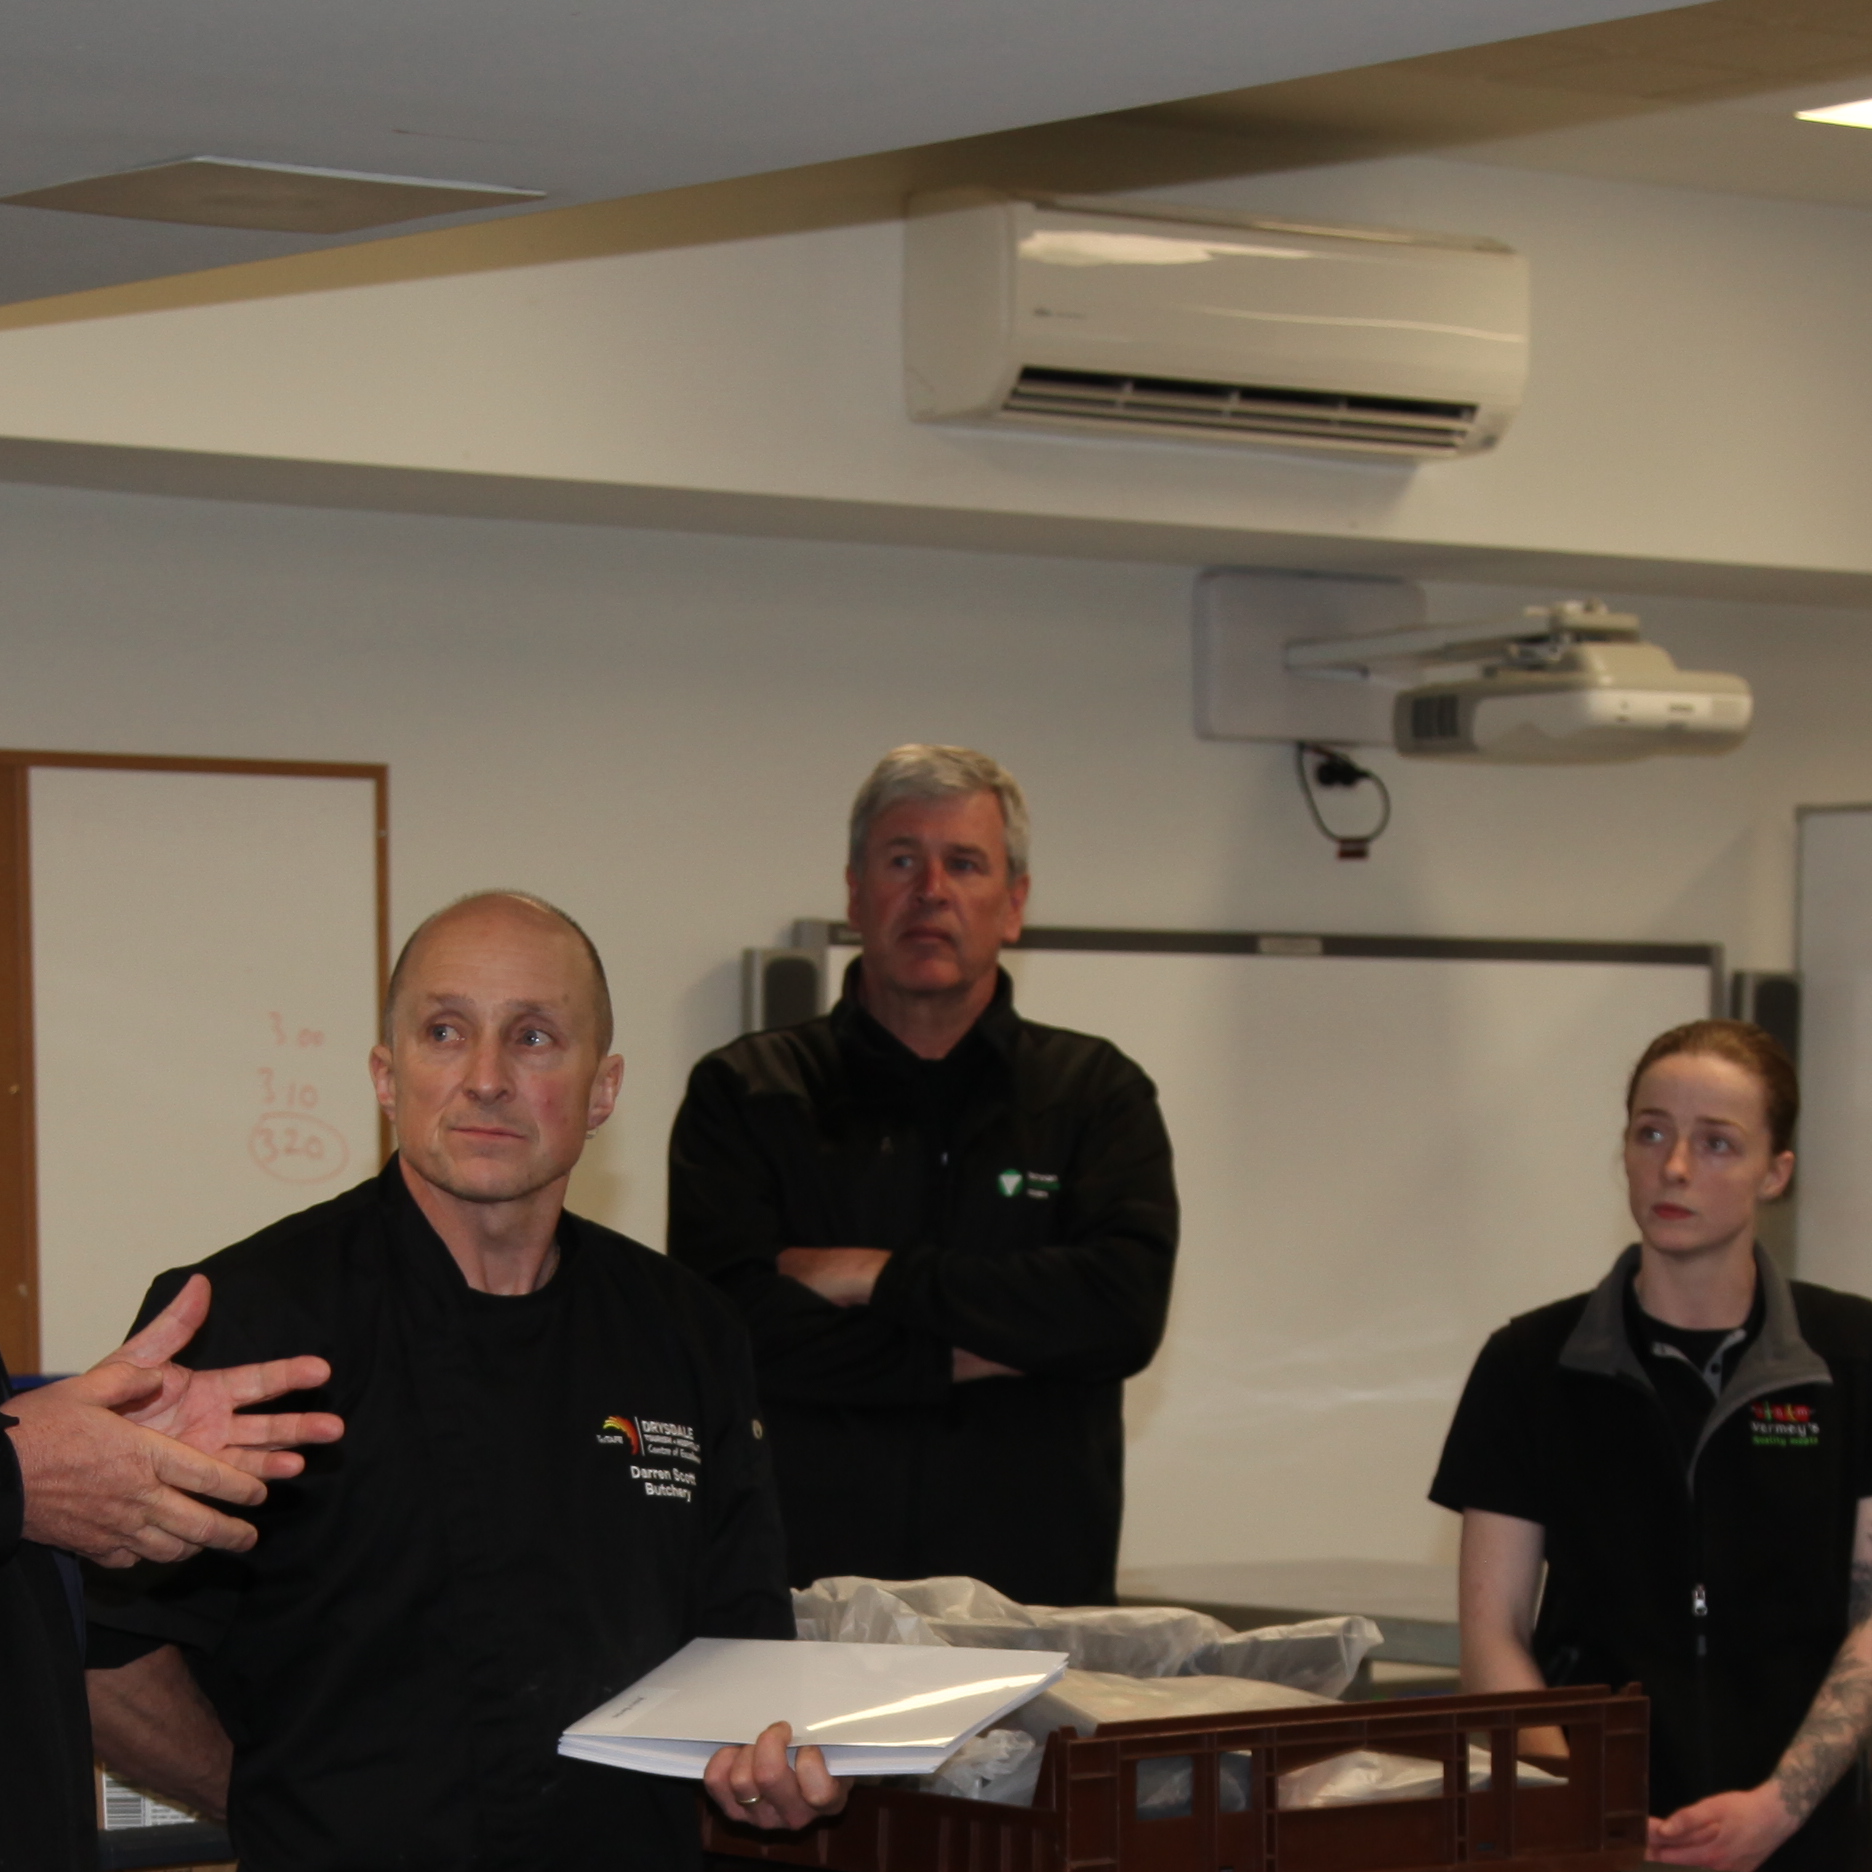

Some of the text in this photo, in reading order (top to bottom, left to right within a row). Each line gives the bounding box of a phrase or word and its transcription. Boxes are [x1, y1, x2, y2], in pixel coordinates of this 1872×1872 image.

[254, 1127, 325, 1163] 320
[641, 1420, 694, 1440] DRYSDALE
[630, 1465, 697, 1486] Darren Scott
[645, 1482, 692, 1503] Butchery
